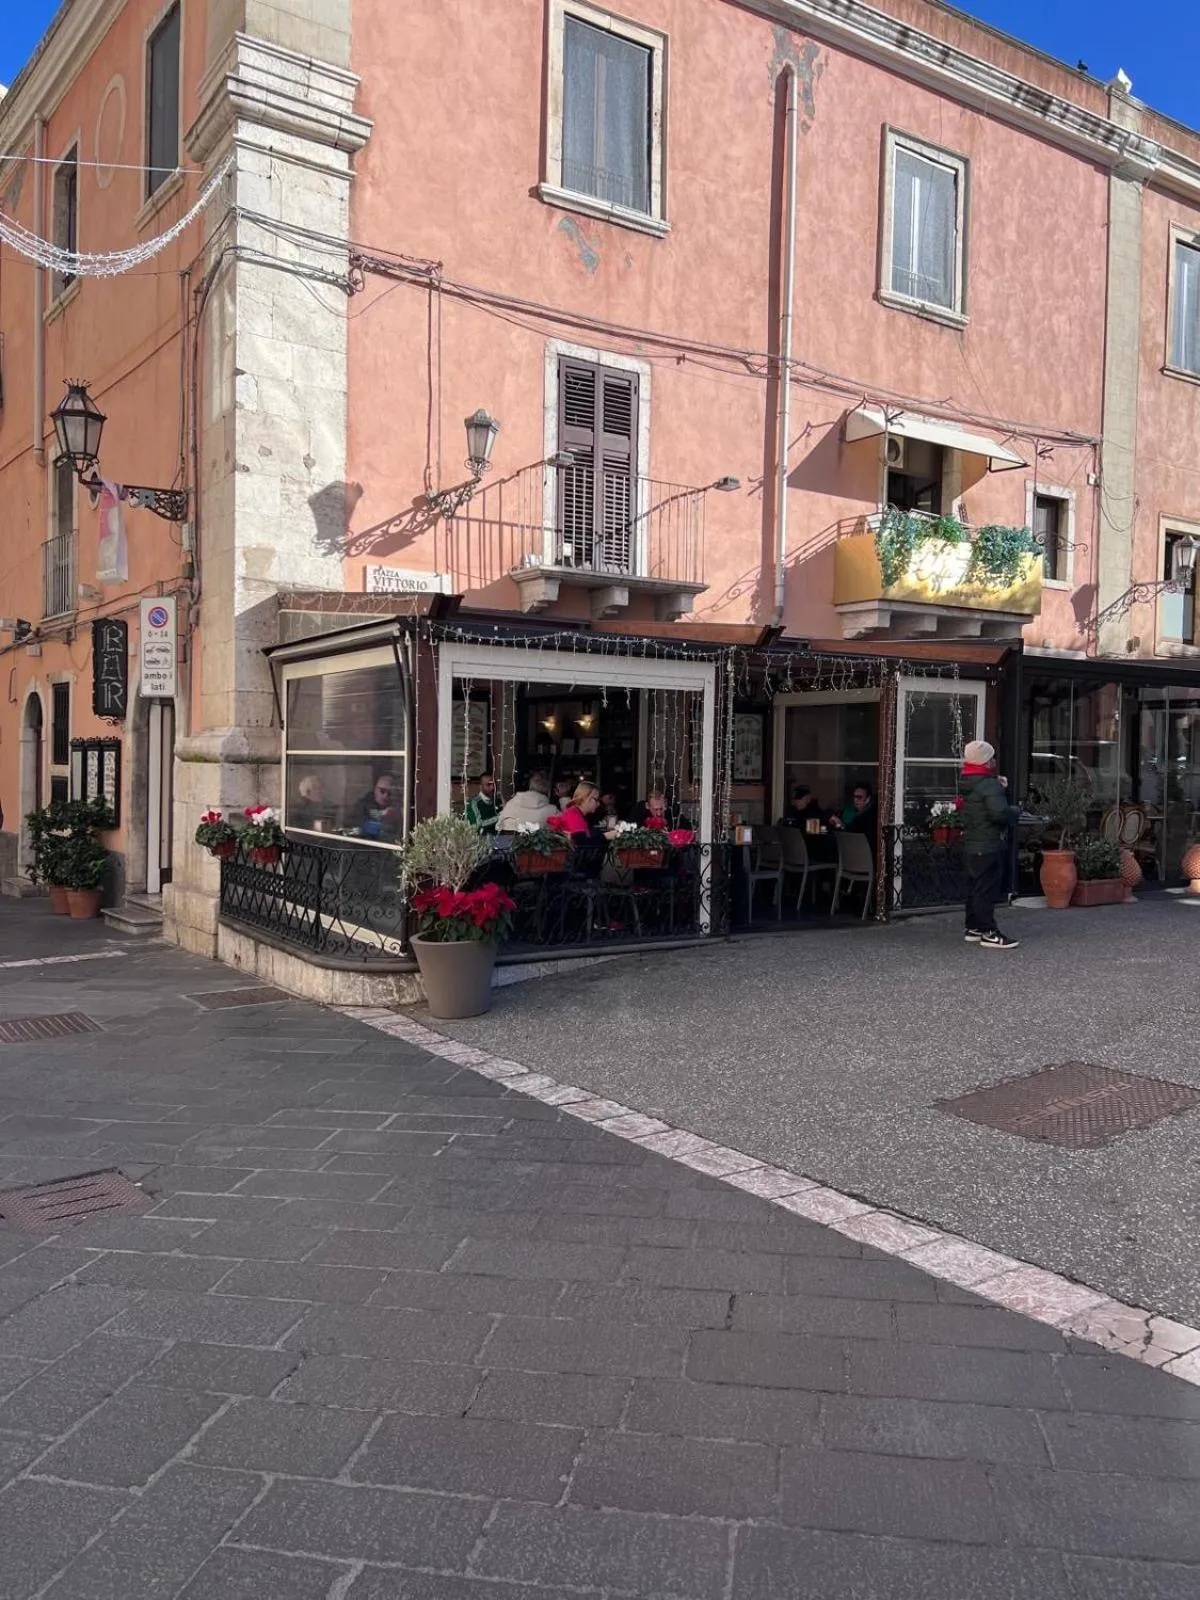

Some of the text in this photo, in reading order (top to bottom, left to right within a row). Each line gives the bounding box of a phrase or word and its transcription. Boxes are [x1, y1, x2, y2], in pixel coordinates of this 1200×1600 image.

[373, 568, 399, 578] PIAZZA
[373, 576, 428, 591] VITTORIO
[101, 625, 124, 709] BAR
[144, 671, 167, 680] ambo
[151, 682, 165, 691] lati
